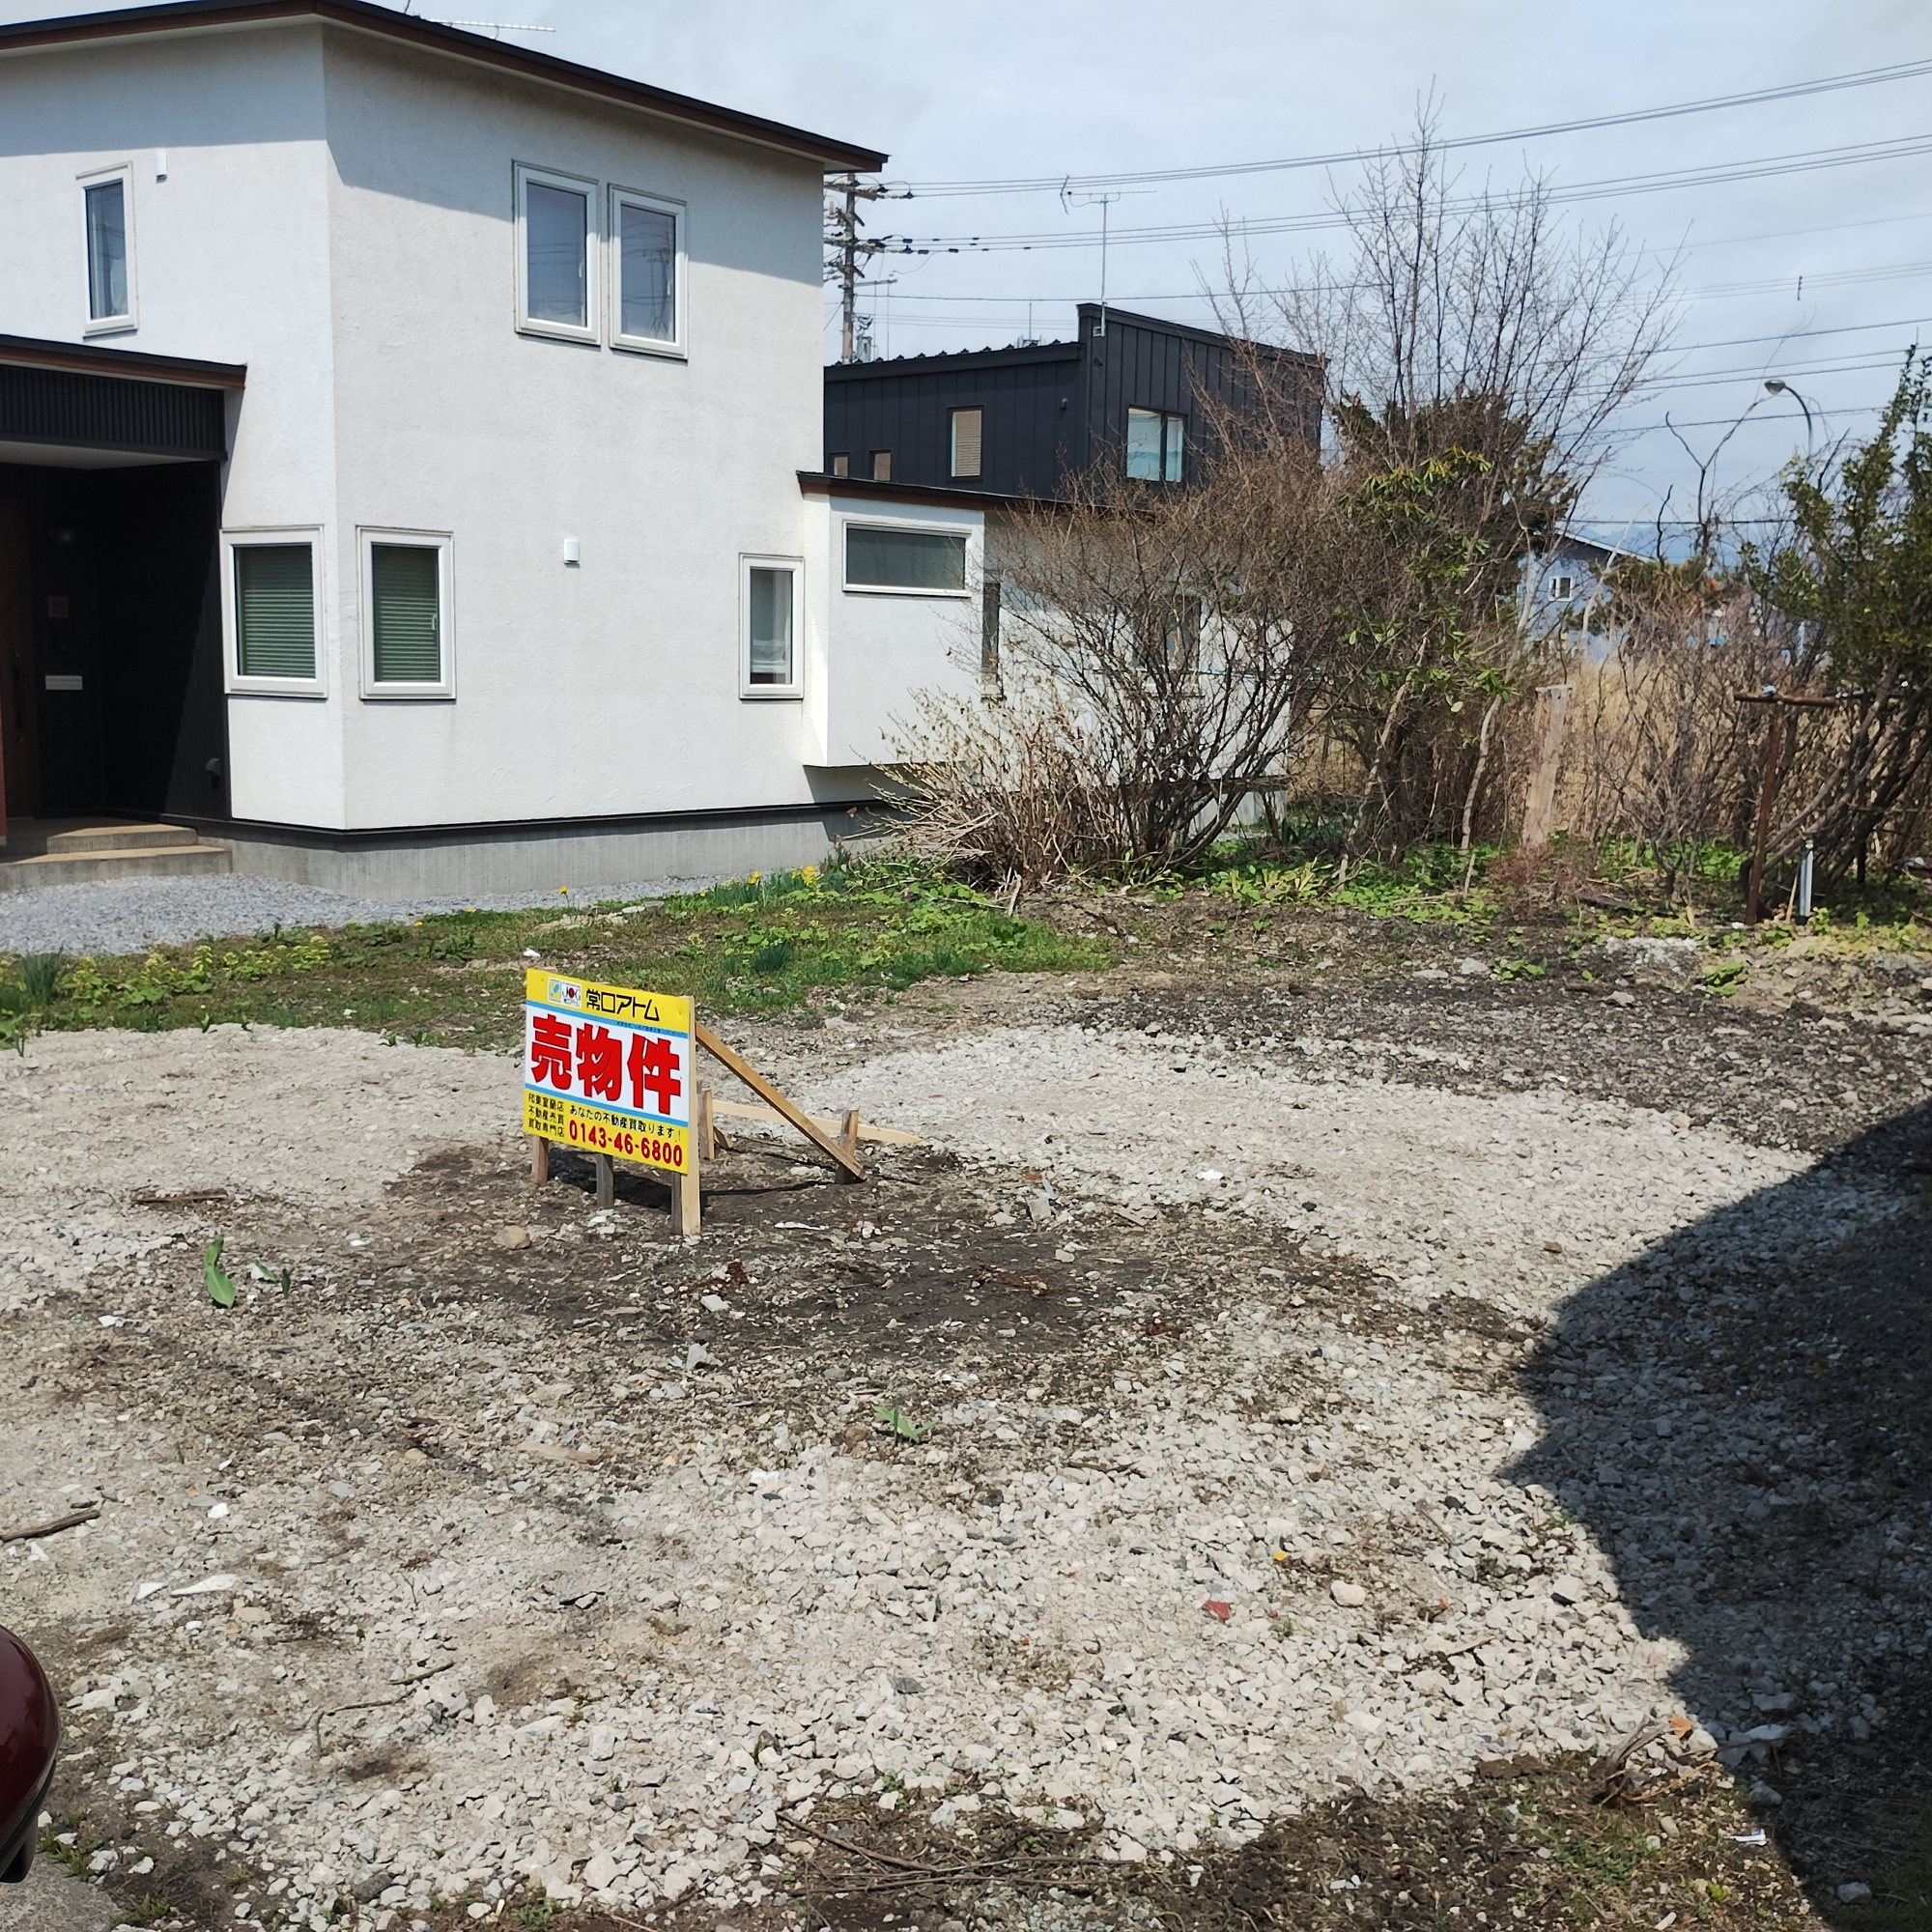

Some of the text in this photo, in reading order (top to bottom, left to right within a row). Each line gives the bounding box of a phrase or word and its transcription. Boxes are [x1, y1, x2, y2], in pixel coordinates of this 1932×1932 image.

[585, 988, 660, 1022] 常口アトム
[531, 1013, 681, 1116] 売物件
[528, 1105, 564, 1124] 不動産売買
[528, 1118, 564, 1137] 買取専門店
[569, 1120, 683, 1167] 0143-46-6800
